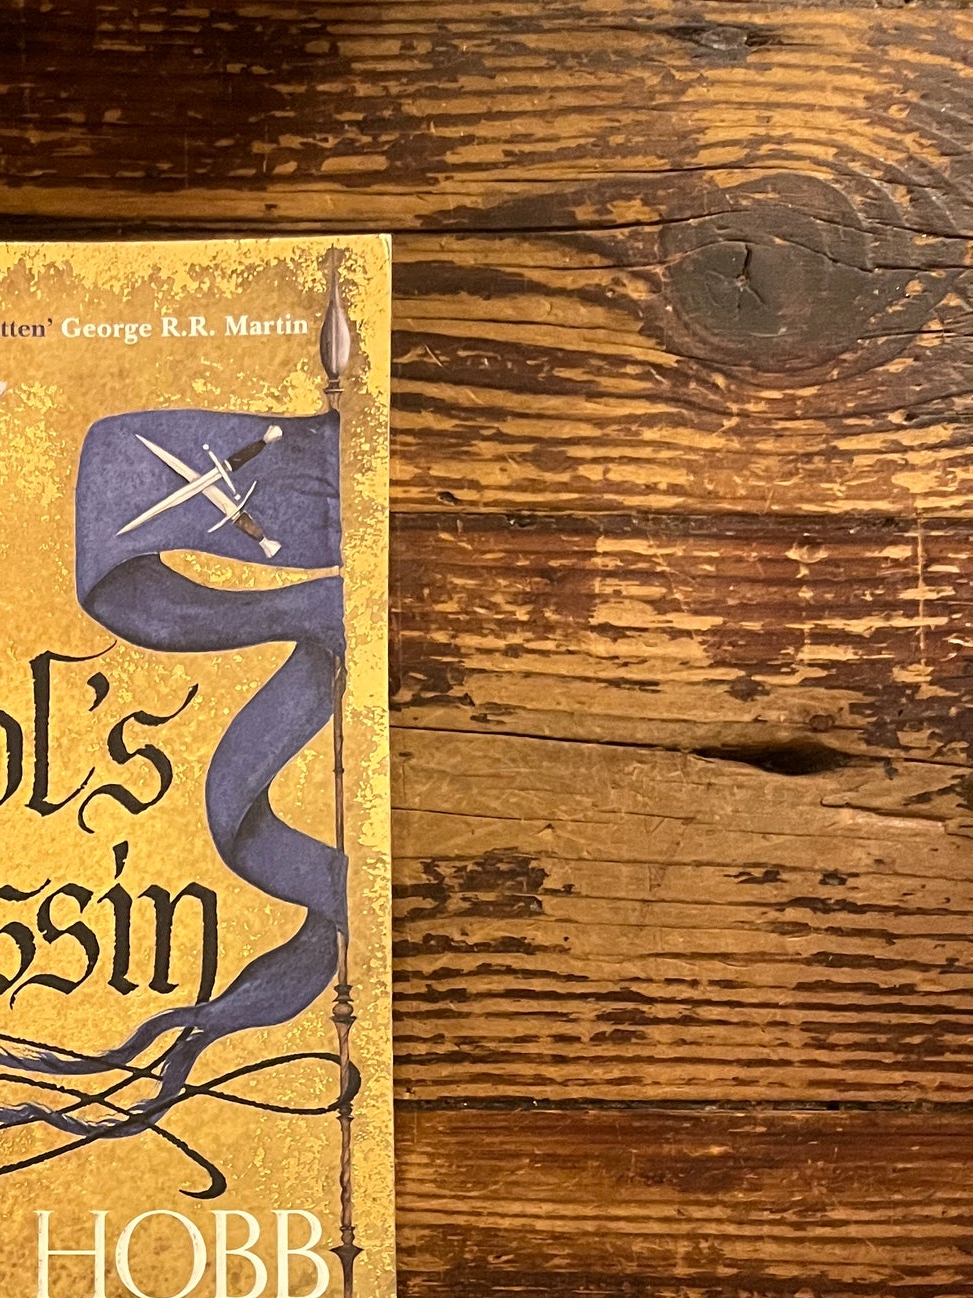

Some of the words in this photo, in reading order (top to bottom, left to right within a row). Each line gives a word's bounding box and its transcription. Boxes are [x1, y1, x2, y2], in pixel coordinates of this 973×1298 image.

[61, 316, 152, 344] George
[161, 316, 215, 337] R.R.
[225, 313, 308, 337] Martin
